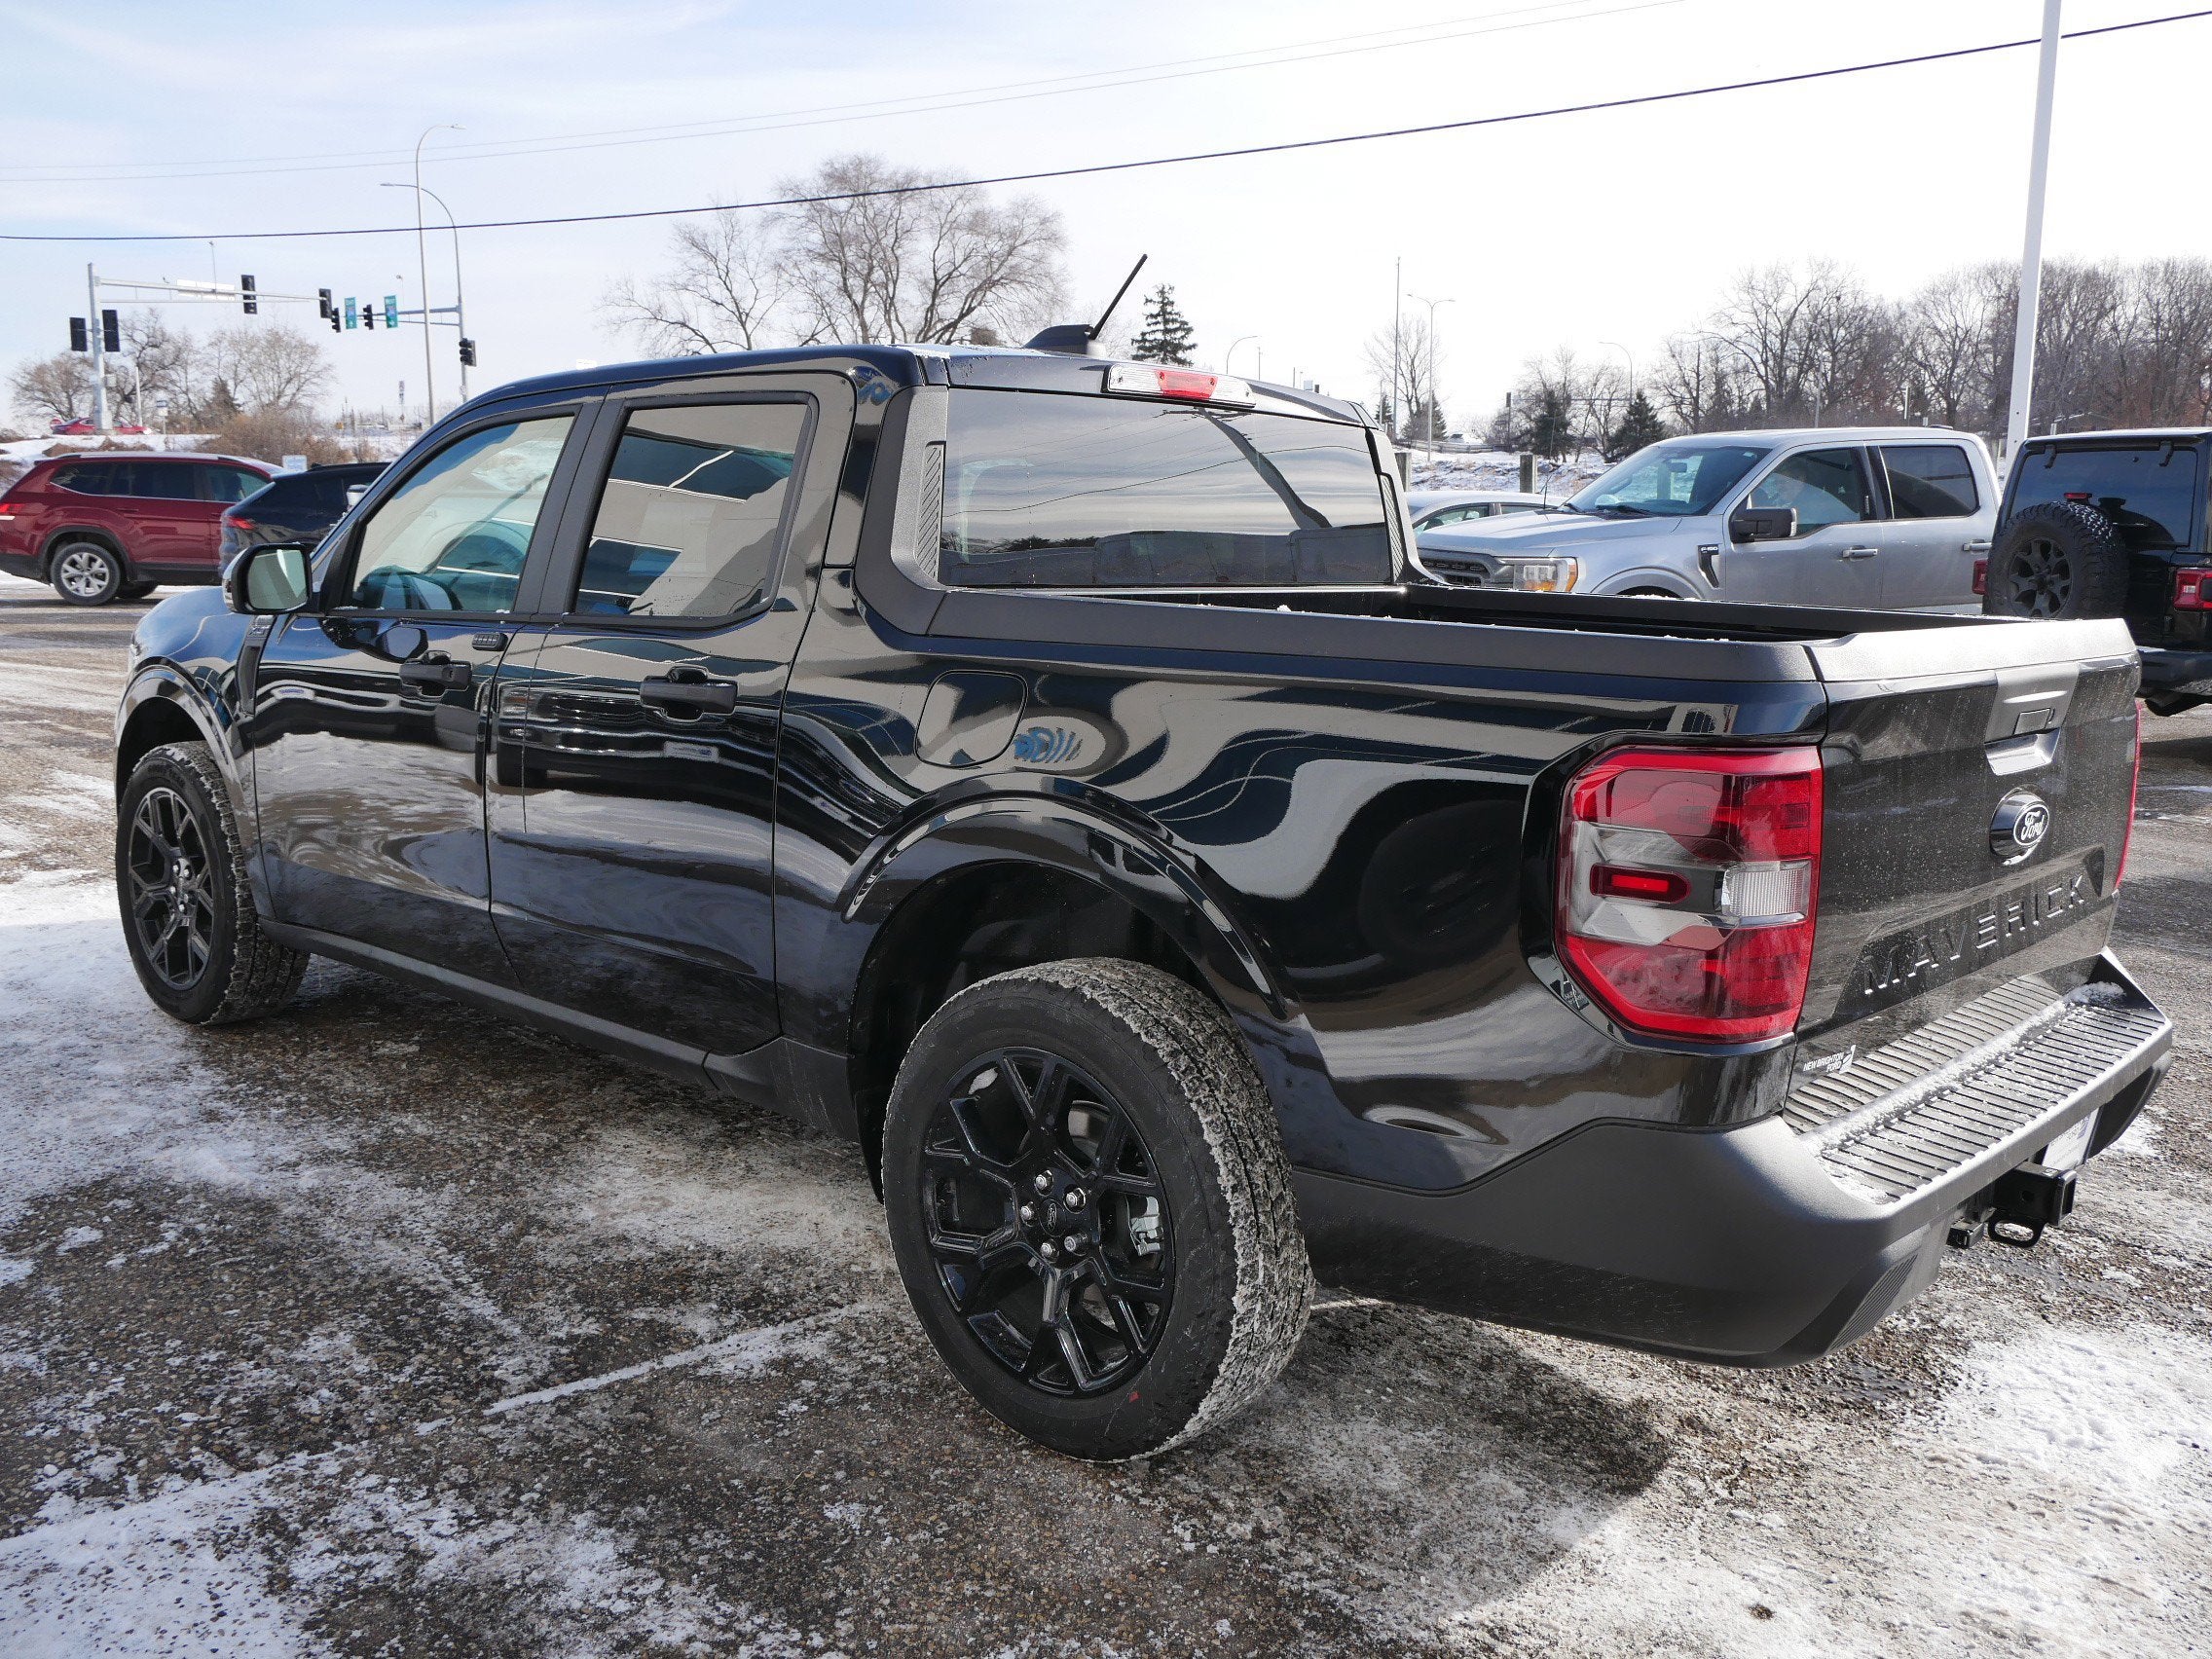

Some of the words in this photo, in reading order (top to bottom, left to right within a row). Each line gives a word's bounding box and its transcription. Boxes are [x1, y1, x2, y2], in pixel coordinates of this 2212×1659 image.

[1862, 874, 2084, 995] MAVERICK
[1803, 1060, 1817, 1071] NEW
[1816, 1051, 1844, 1067] BRIGHTON
[1825, 1060, 1841, 1072] FORD
